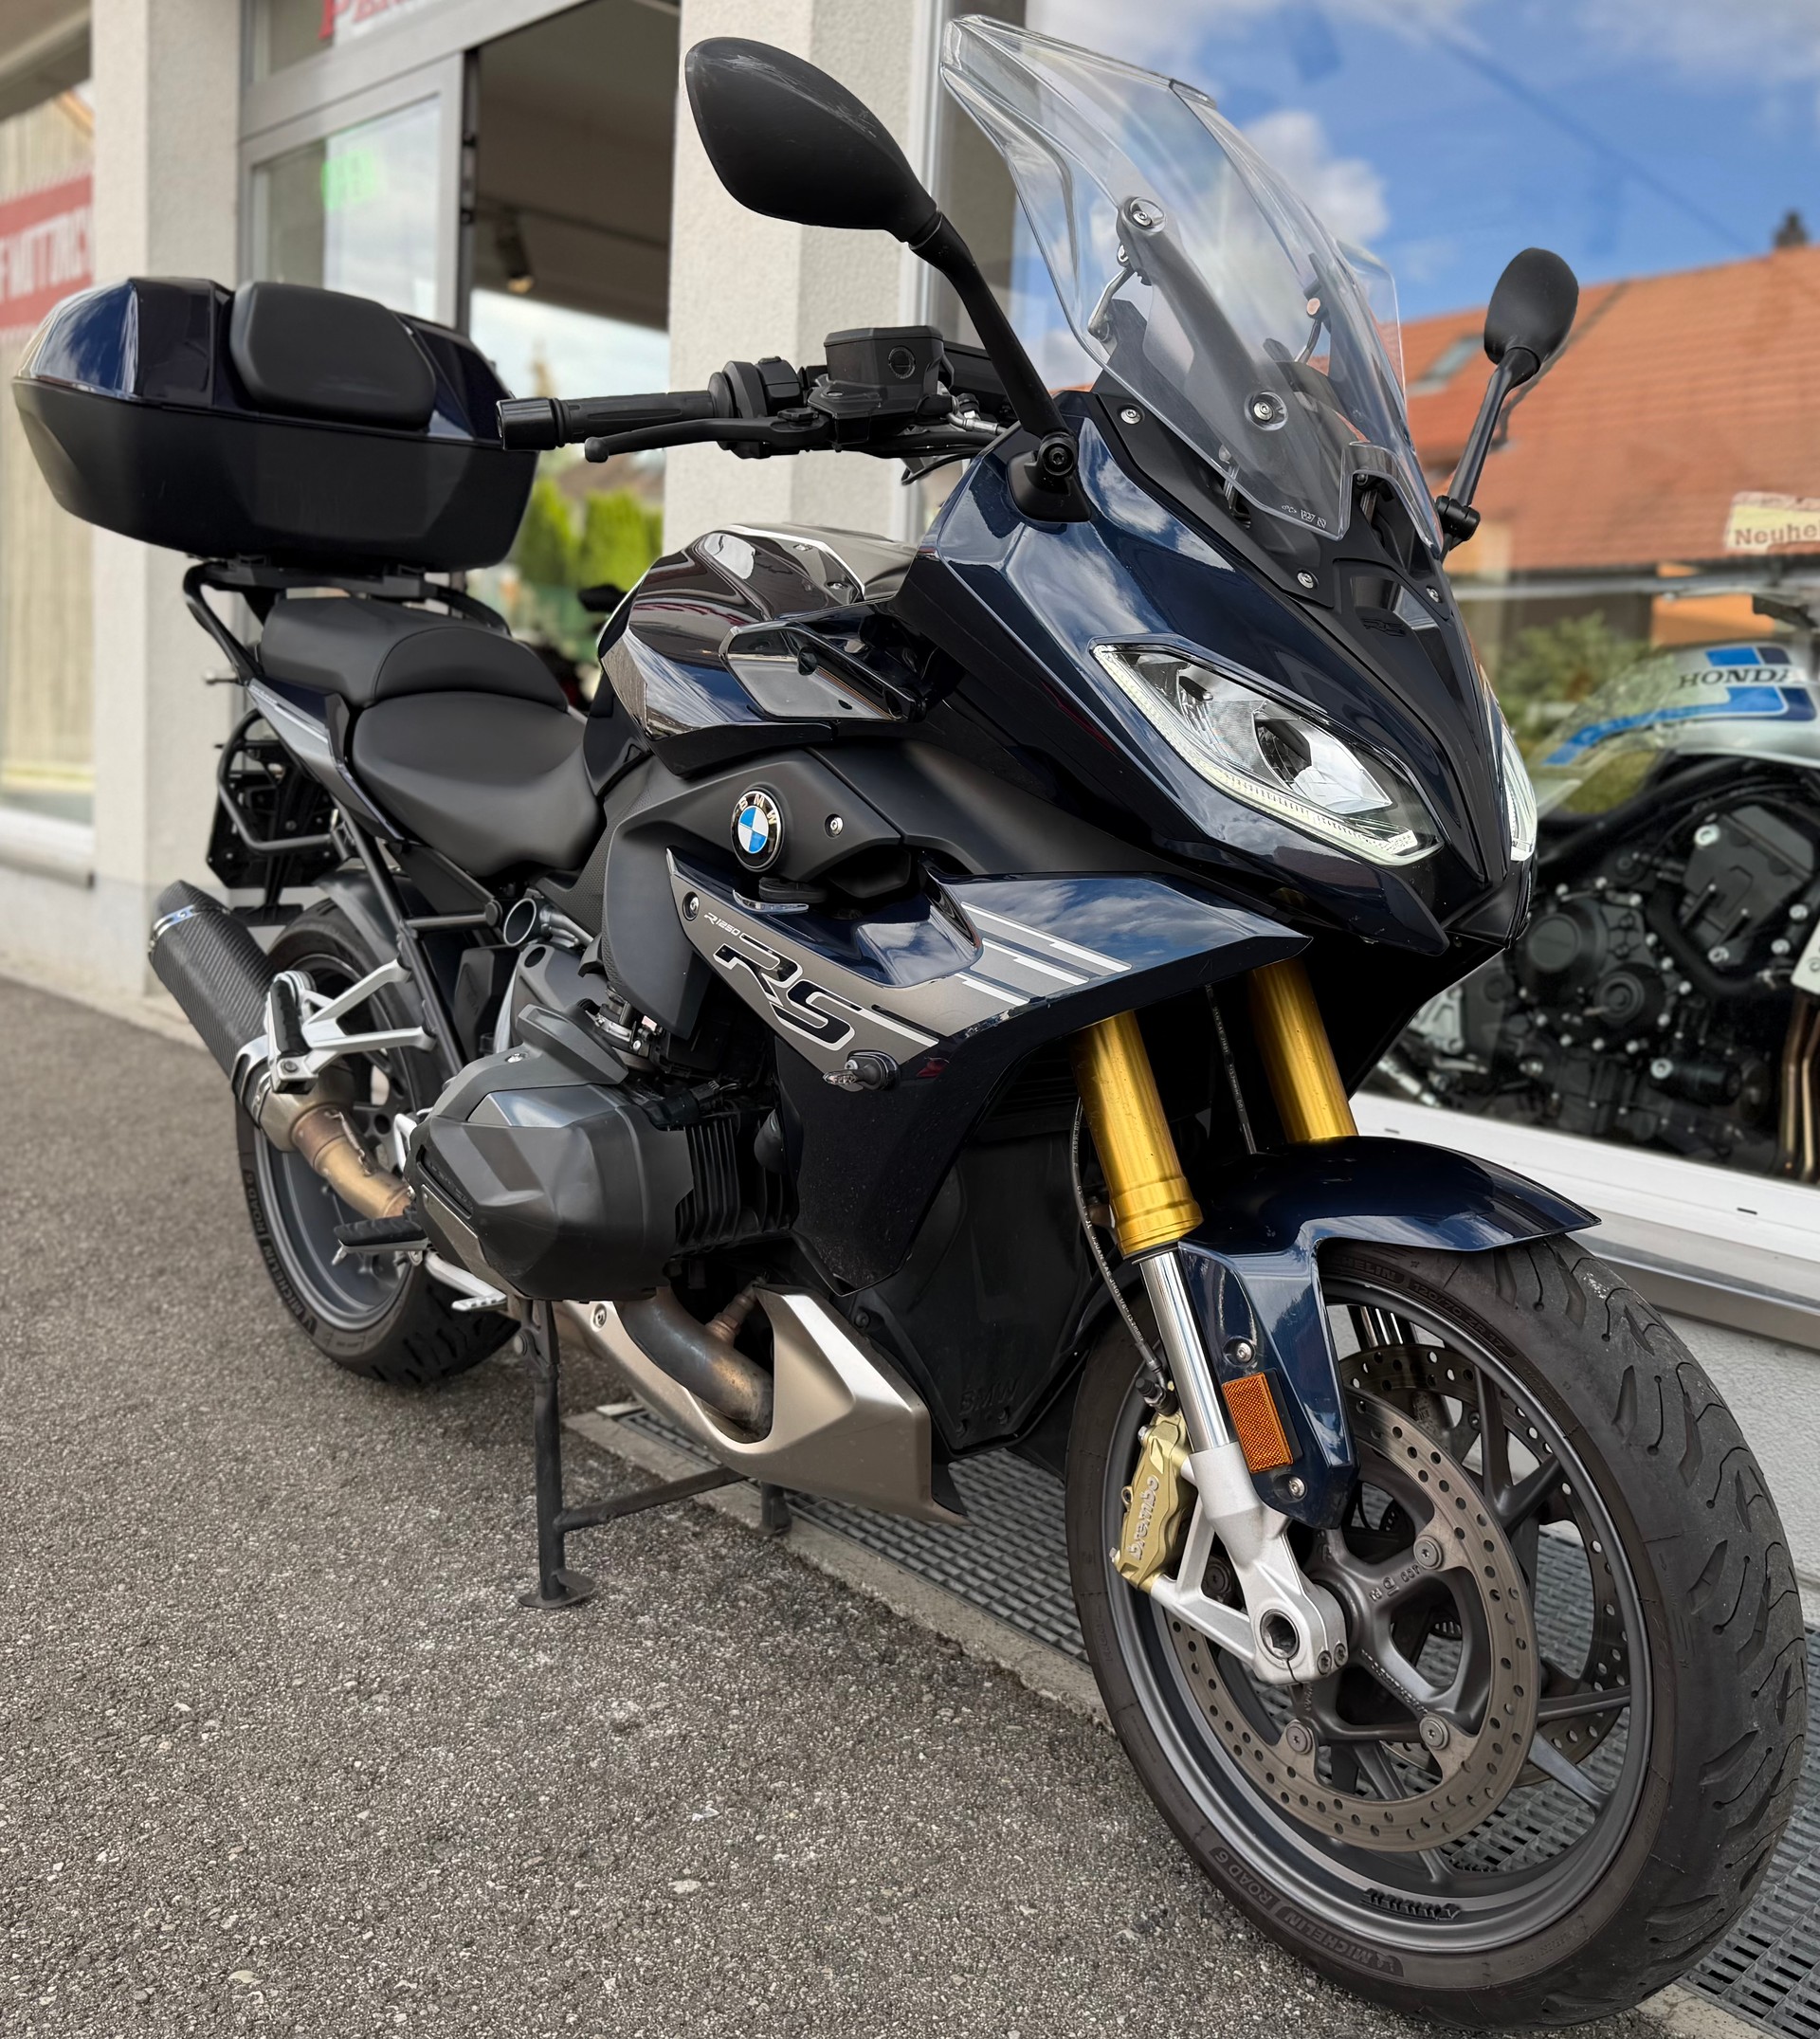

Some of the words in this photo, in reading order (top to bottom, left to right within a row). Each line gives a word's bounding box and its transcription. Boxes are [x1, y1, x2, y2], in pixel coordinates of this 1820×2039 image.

[1735, 523, 1820, 546] Neuhe
[738, 793, 777, 826] BMW
[703, 912, 741, 937] R1250
[713, 932, 863, 1051] RS
[247, 1187, 266, 1232] ROAD
[264, 1244, 306, 1316] MICHELIN
[1413, 1282, 1463, 1317] 120/70
[1465, 1316, 1487, 1335] ZR
[1488, 1333, 1504, 1348] 17
[1126, 1474, 1159, 1561] brembo
[1214, 1850, 1229, 1865] 6
[1228, 1864, 1273, 1904] ROAD
[1283, 1909, 1373, 1965] MICHELIN
